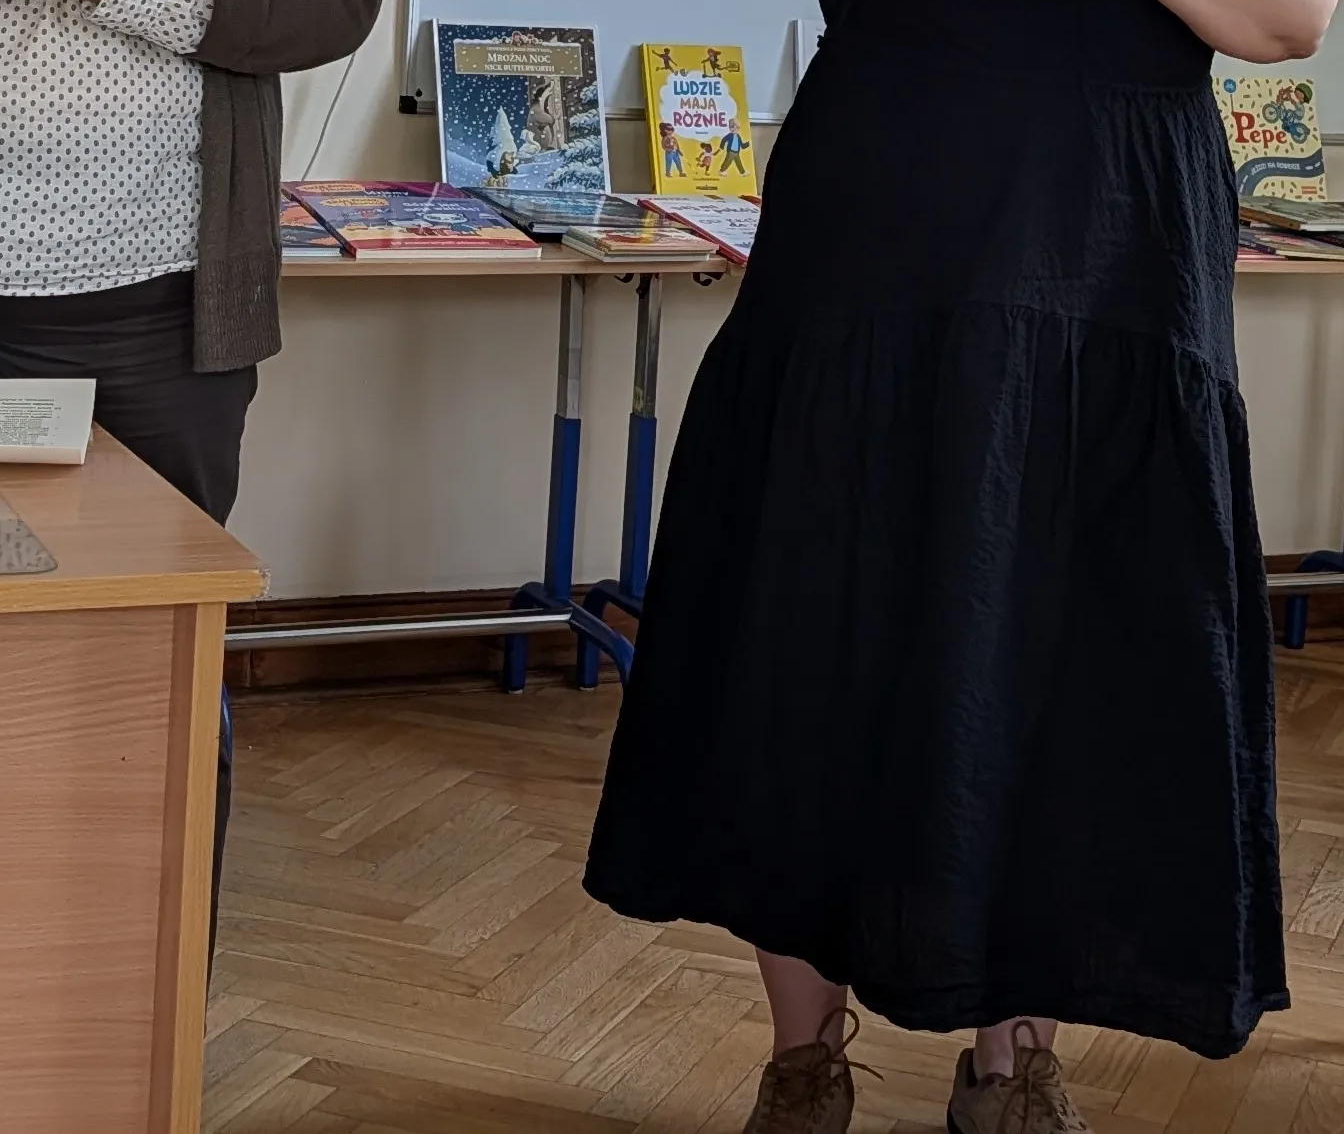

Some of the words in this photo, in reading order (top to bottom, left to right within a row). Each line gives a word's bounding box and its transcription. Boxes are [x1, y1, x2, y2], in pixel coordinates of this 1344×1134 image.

[487, 52, 527, 63] MROŹNA
[529, 54, 550, 63] NOC
[674, 81, 722, 95] LUDZIE
[673, 110, 727, 127] RÓŻNIE
[1231, 111, 1288, 148] Pepe
